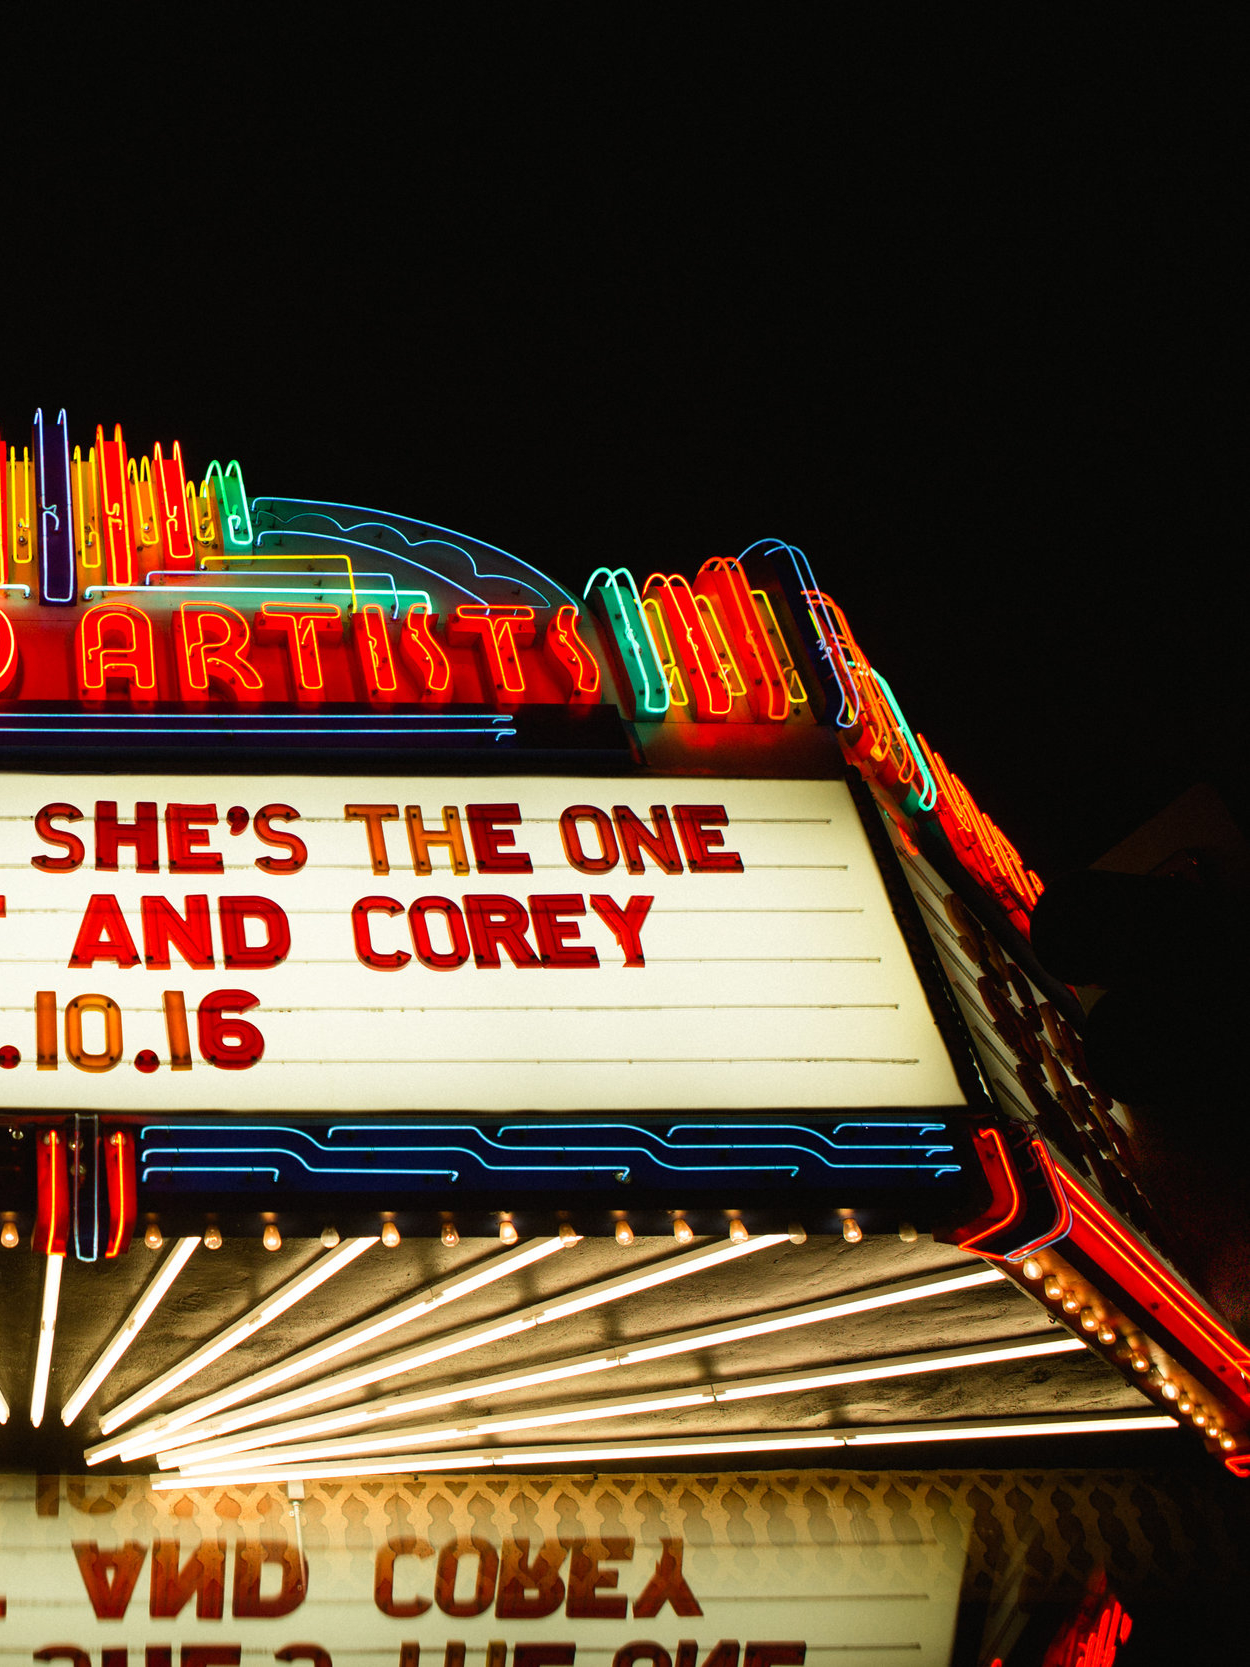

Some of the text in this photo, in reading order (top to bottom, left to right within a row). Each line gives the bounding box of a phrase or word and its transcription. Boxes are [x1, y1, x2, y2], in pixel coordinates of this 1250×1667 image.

[77, 602, 603, 703] ARTISTS
[31, 801, 309, 876] SHE'S
[344, 803, 534, 876] THE
[558, 803, 745, 876] ONE
[67, 893, 292, 971] AND
[350, 893, 655, 972] COREY
